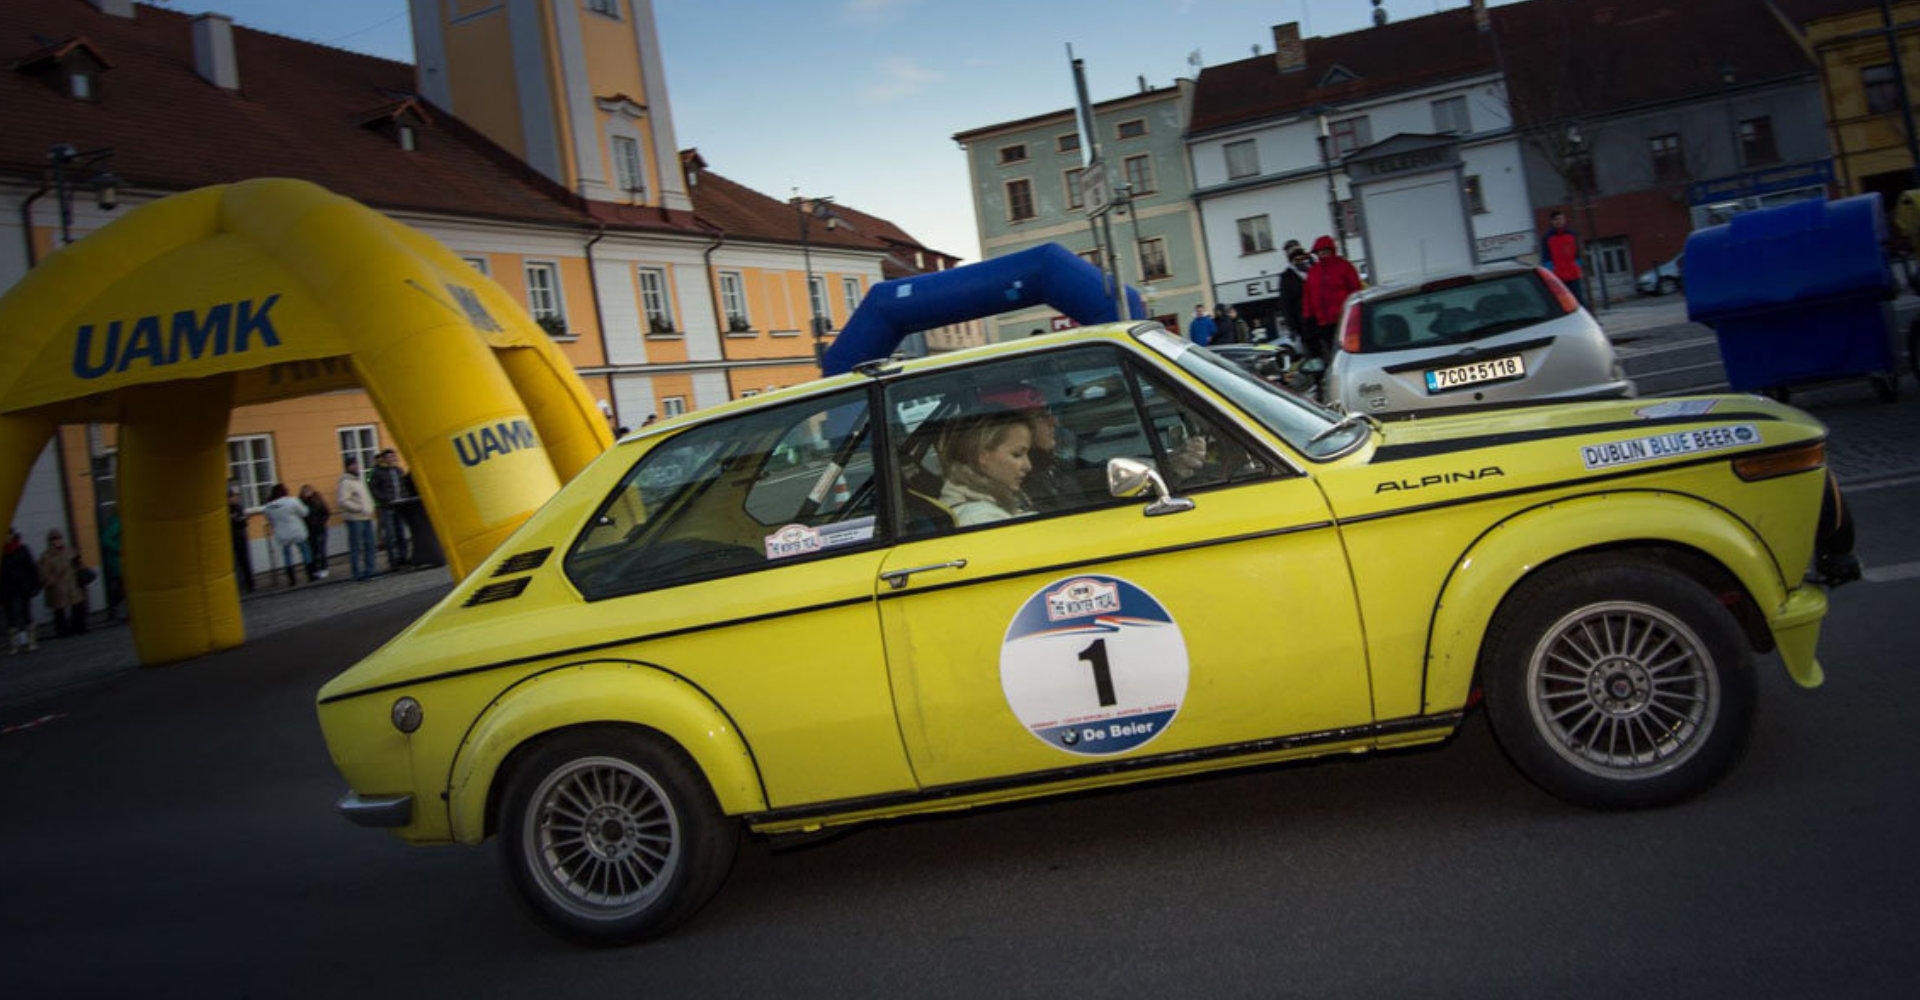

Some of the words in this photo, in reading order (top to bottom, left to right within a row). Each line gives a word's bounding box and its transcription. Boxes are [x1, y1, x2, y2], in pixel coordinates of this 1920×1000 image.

[73, 293, 283, 380] UAMK
[1478, 359, 1517, 379] 5118
[1585, 440, 1647, 465] DUBLIN
[1649, 434, 1691, 455] BLUE
[1693, 428, 1735, 448] BEER
[1375, 466, 1505, 494] ALPINA
[1078, 638, 1117, 707] 1
[1083, 728, 1105, 741] De
[1109, 722, 1154, 738] Beier
